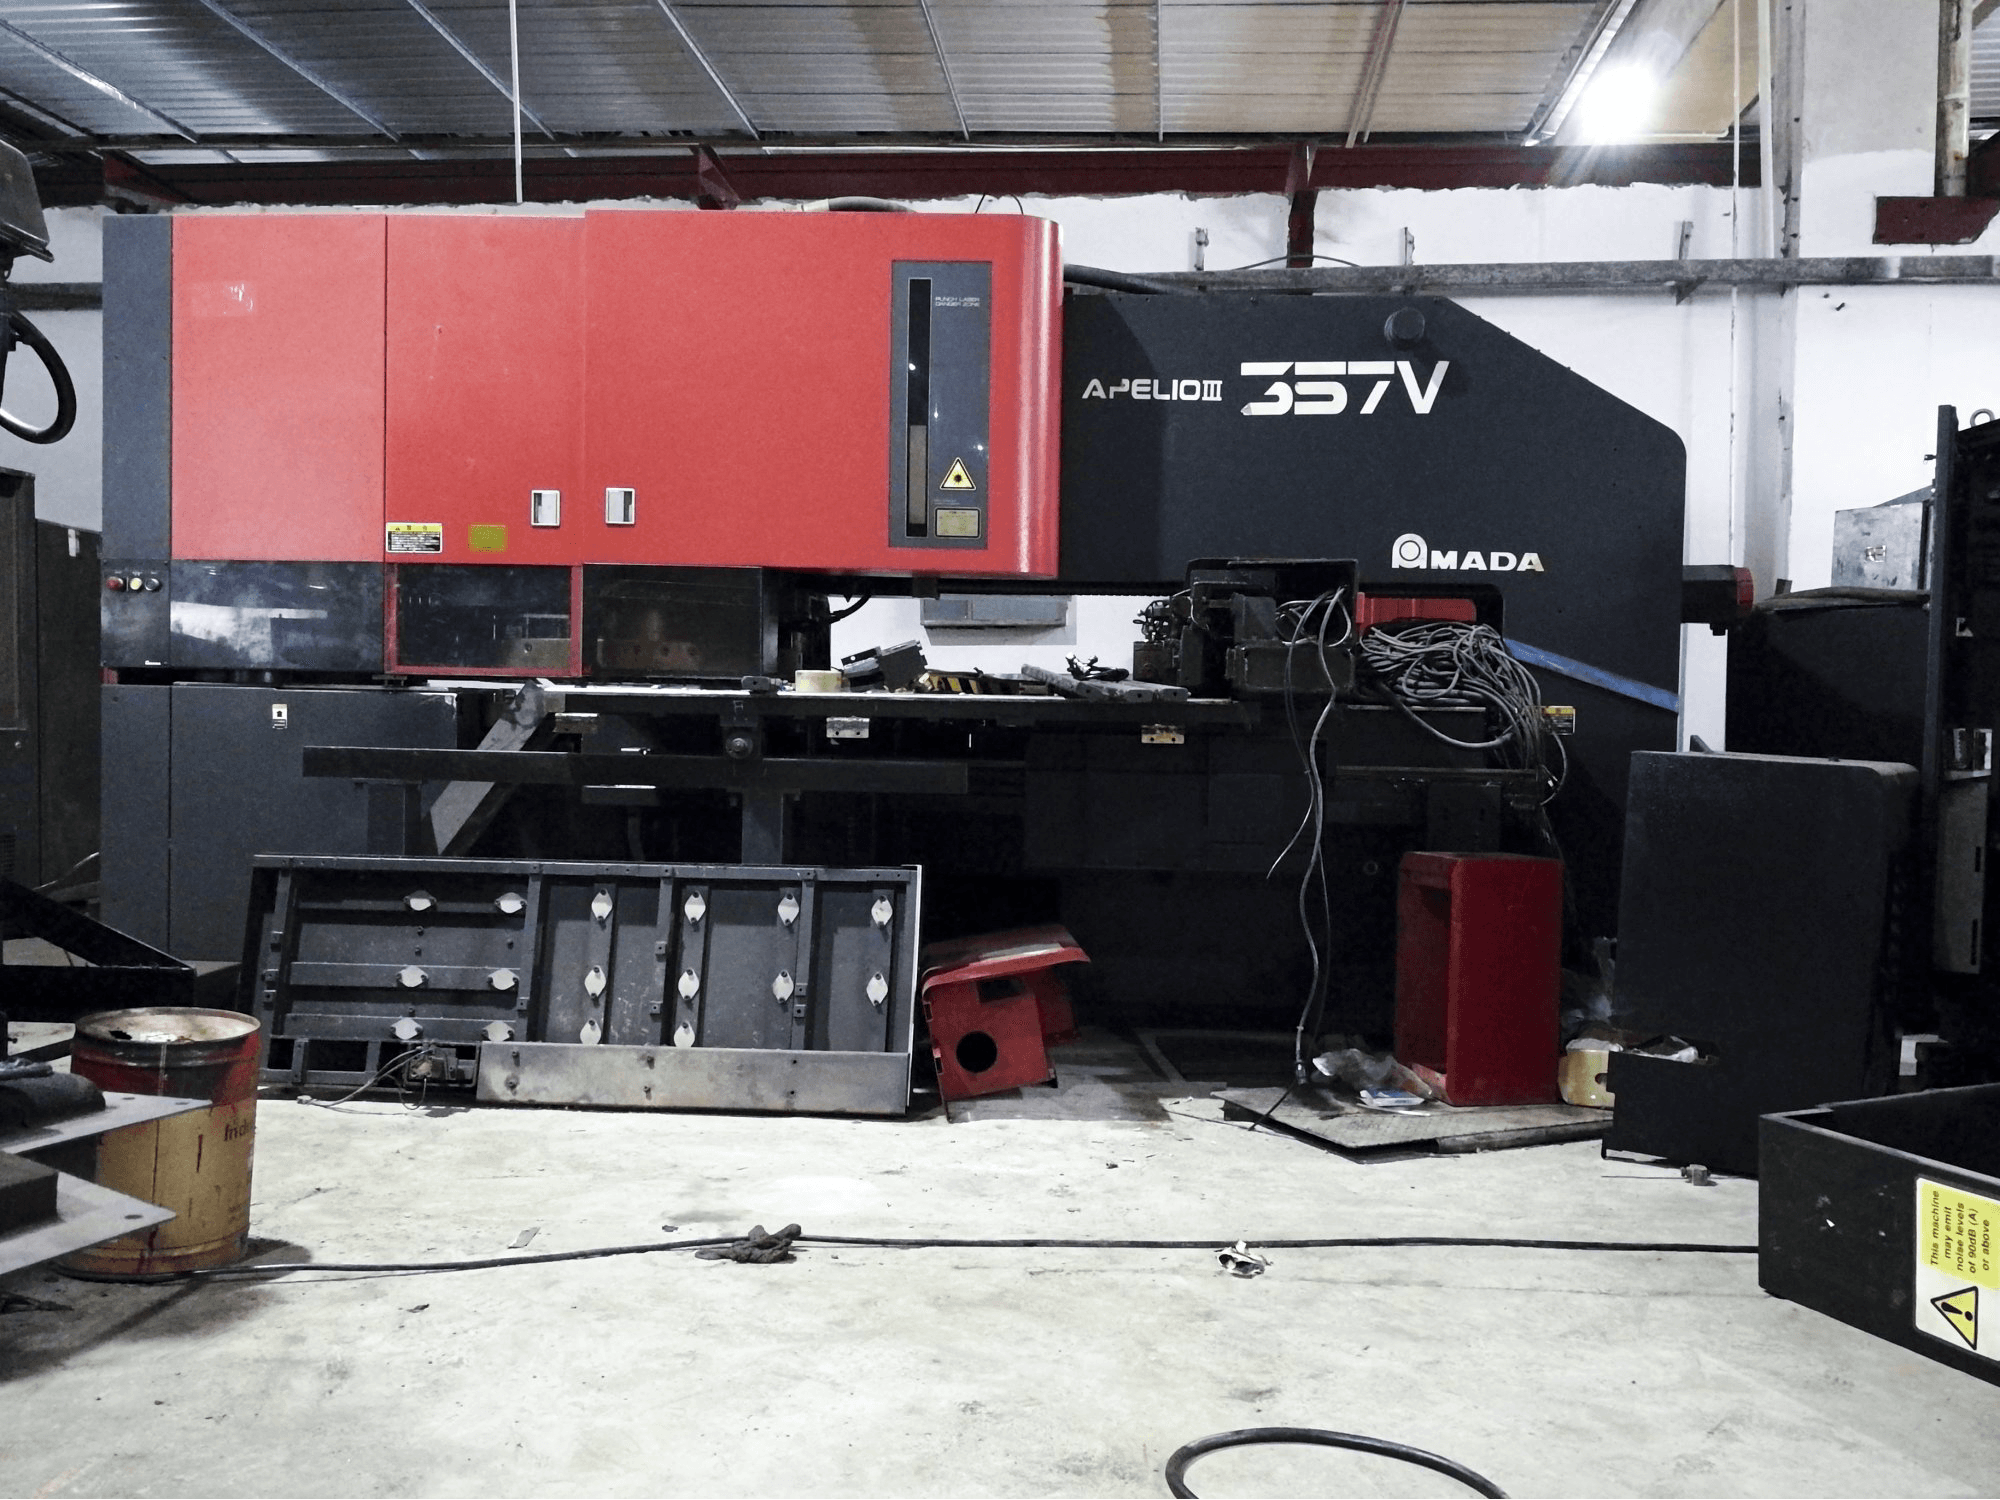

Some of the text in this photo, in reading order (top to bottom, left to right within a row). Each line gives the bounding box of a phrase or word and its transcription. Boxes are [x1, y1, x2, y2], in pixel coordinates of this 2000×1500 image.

[1240, 360, 1450, 416] 357V
[1391, 533, 1545, 572] AMADA
[1930, 1191, 1939, 1265] This machine
[1943, 1206, 1953, 1259] may emit
[1956, 1202, 1964, 1272] noise levels
[1968, 1208, 1979, 1274] of 90dB (A)
[1981, 1219, 1990, 1271] or above
